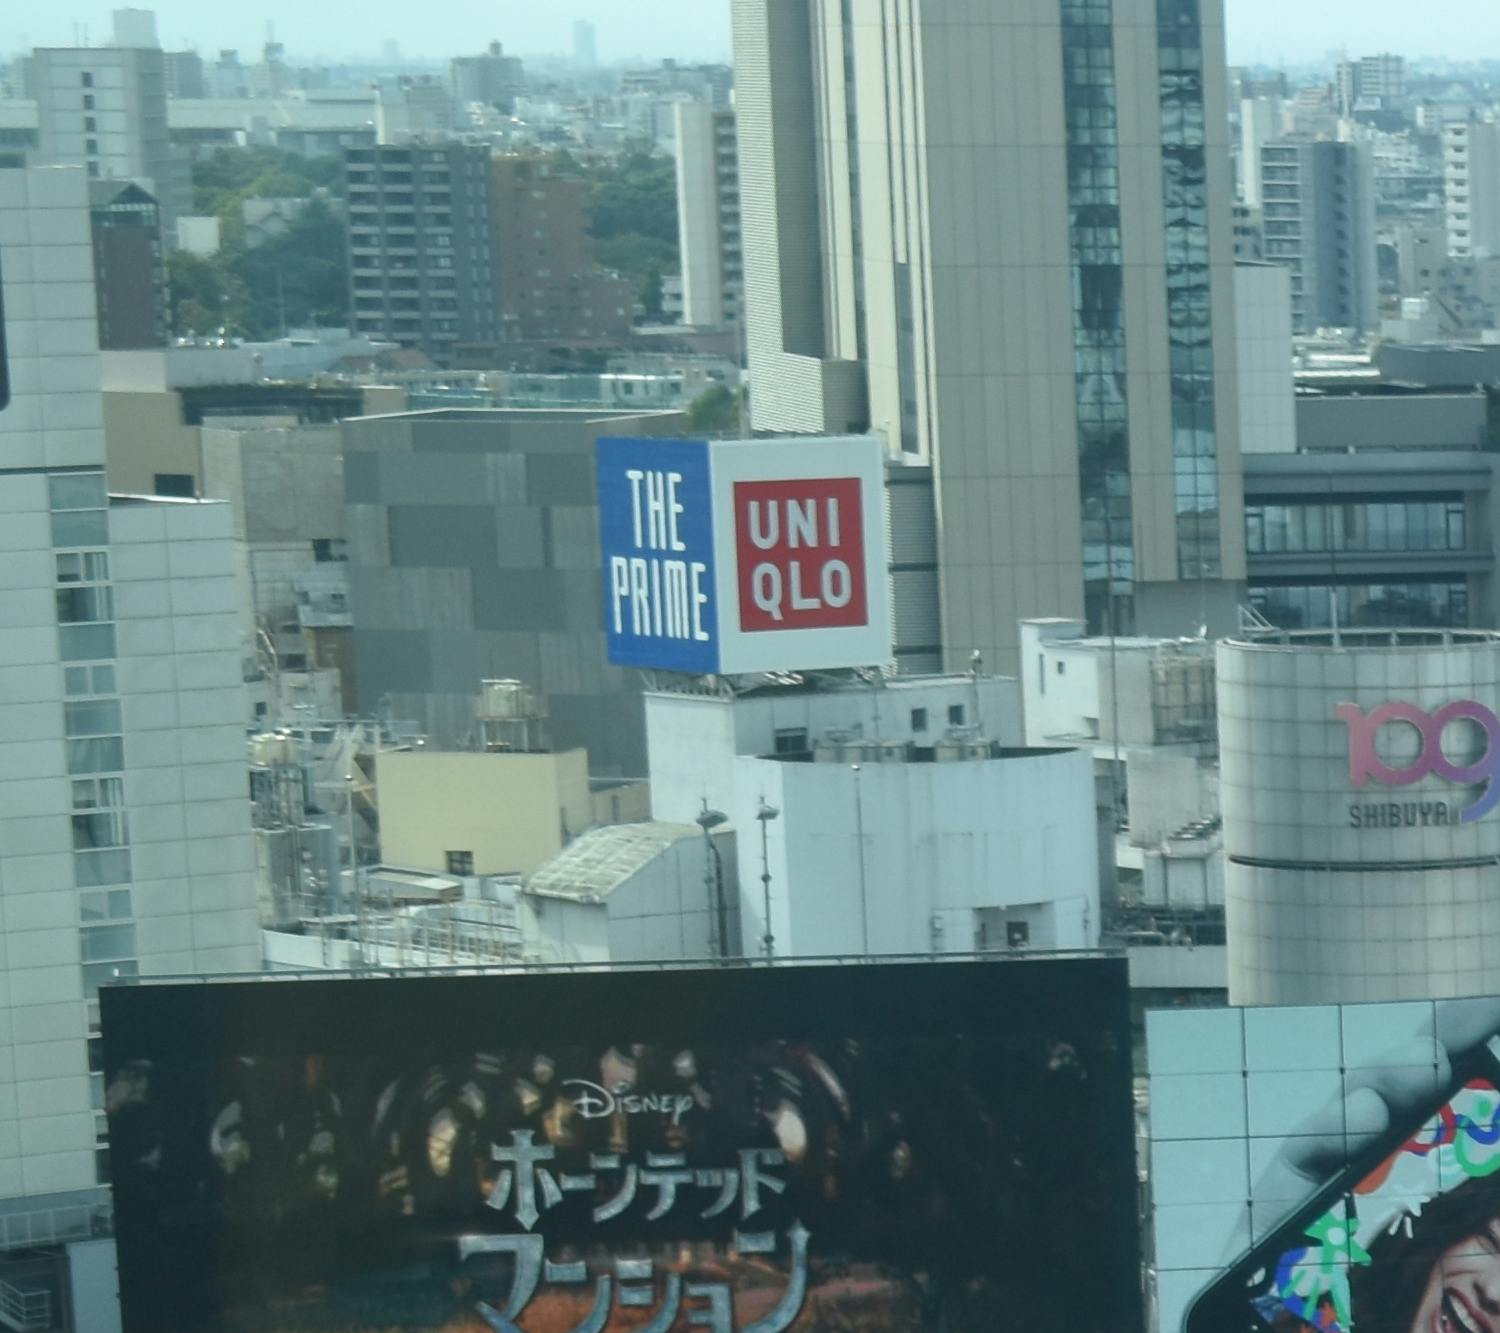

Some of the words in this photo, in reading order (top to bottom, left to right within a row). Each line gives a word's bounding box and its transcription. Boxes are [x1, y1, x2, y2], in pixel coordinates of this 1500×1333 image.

[627, 469, 685, 551] THE
[747, 498, 841, 550] UNI
[611, 556, 710, 642] PRIME
[749, 557, 853, 623] QLO
[1349, 802, 1449, 829] SHIBUYA
[485, 1128, 790, 1229] ホーンテッド
